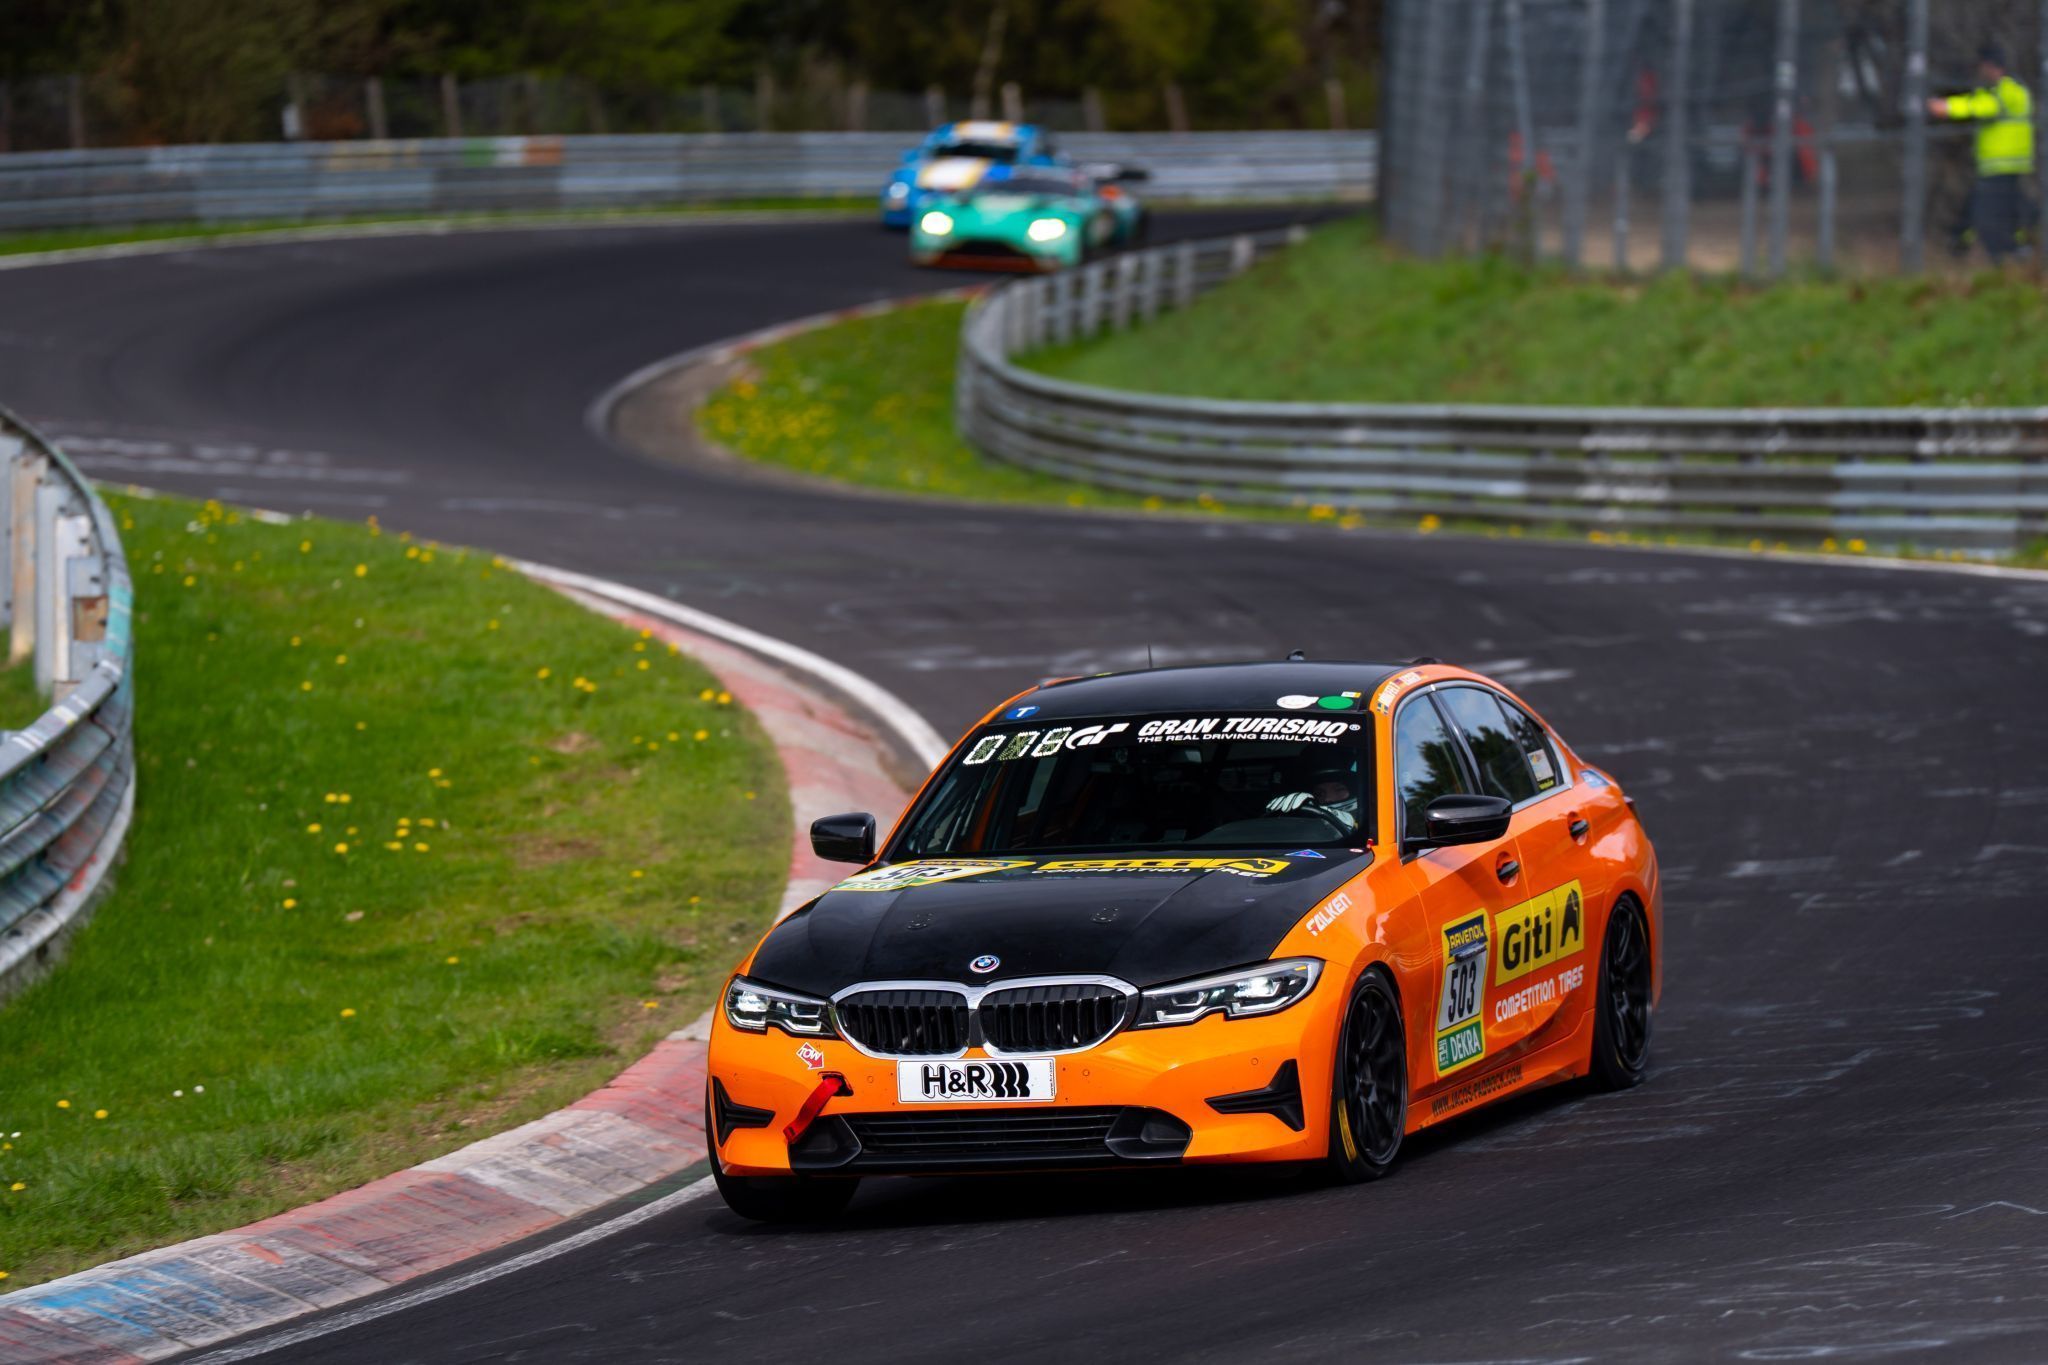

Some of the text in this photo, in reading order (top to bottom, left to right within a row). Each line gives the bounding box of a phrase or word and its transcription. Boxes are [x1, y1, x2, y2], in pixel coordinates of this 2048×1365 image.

[1016, 706, 1036, 718] T
[1138, 718, 1221, 737] GRAN
[1165, 734, 1200, 742] REAL
[1259, 733, 1338, 744] SIMULATOR
[1306, 892, 1353, 937] FALKEN
[1449, 924, 1485, 949] RAVENOL
[1502, 907, 1552, 971] Giti
[1447, 960, 1477, 1023] 503
[1495, 964, 1585, 1023] COMPETITION TIRES
[799, 1047, 819, 1061] TOW
[1450, 1026, 1481, 1062] DEKRA
[921, 1064, 992, 1097] H&R
